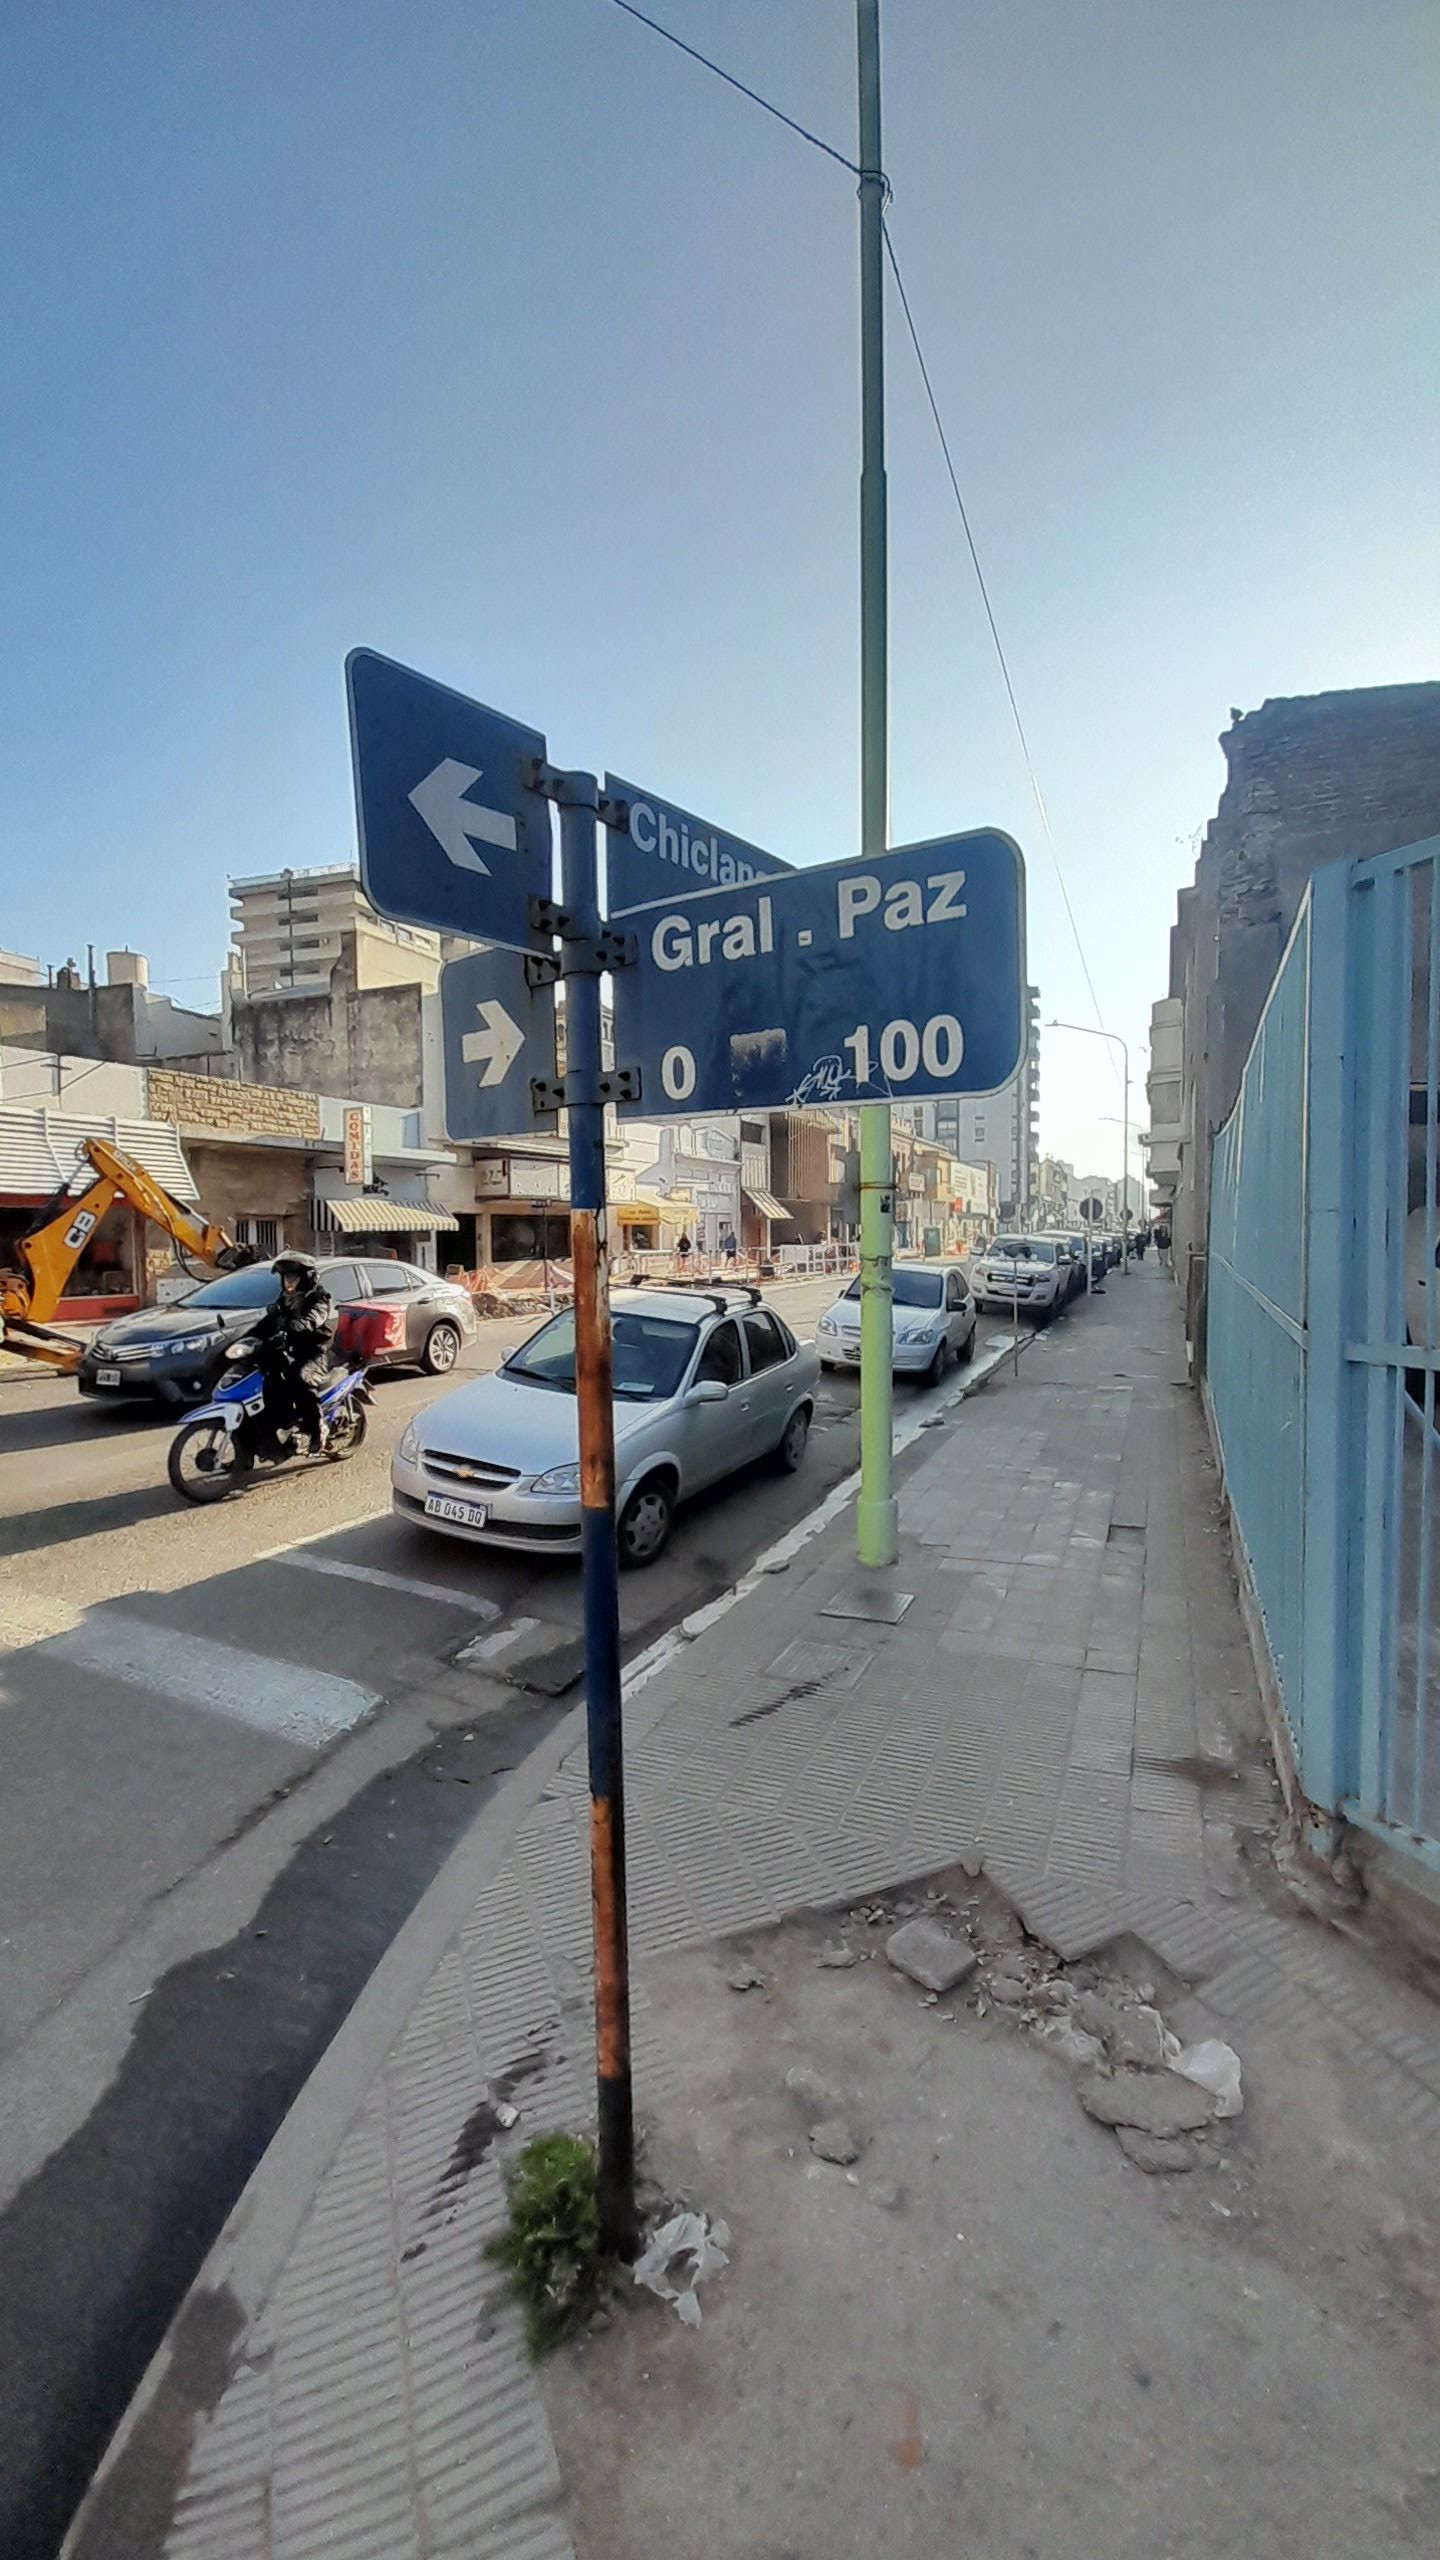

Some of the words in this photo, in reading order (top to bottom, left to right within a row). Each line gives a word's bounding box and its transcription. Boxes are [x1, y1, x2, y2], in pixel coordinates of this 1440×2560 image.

[837, 870, 967, 939] Paz
[661, 1045, 696, 1100] 0
[844, 1014, 964, 1082] 100
[348, 1112, 360, 1179] COMIDAS
